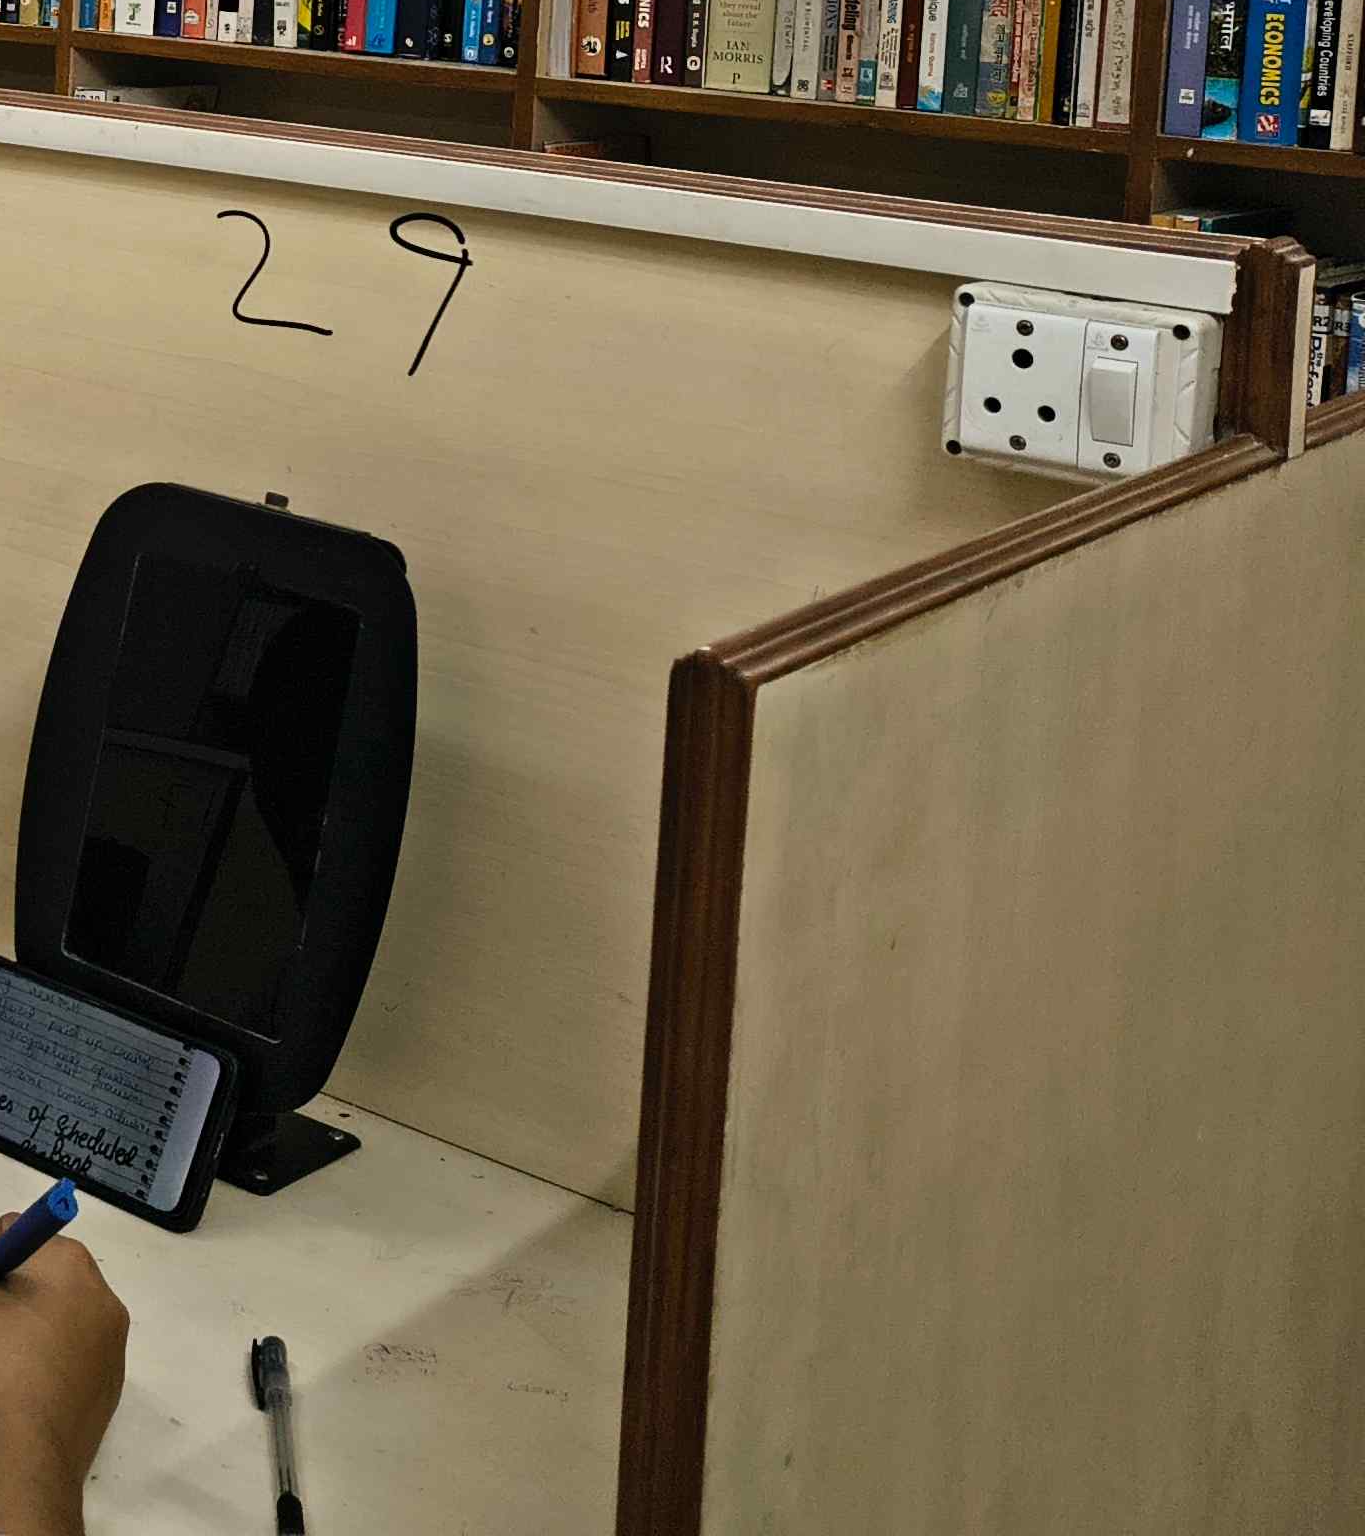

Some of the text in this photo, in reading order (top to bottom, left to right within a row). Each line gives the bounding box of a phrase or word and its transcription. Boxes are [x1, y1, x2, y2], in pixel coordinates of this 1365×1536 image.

[712, 52, 764, 64] MORRIS
[726, 40, 749, 50] IAN
[1259, 13, 1285, 105] ECONOMICS
[1317, 50, 1333, 96] Countries
[217, 210, 473, 377] 29
[28, 1104, 50, 1140] of
[56, 1114, 137, 1167] Scheduled
